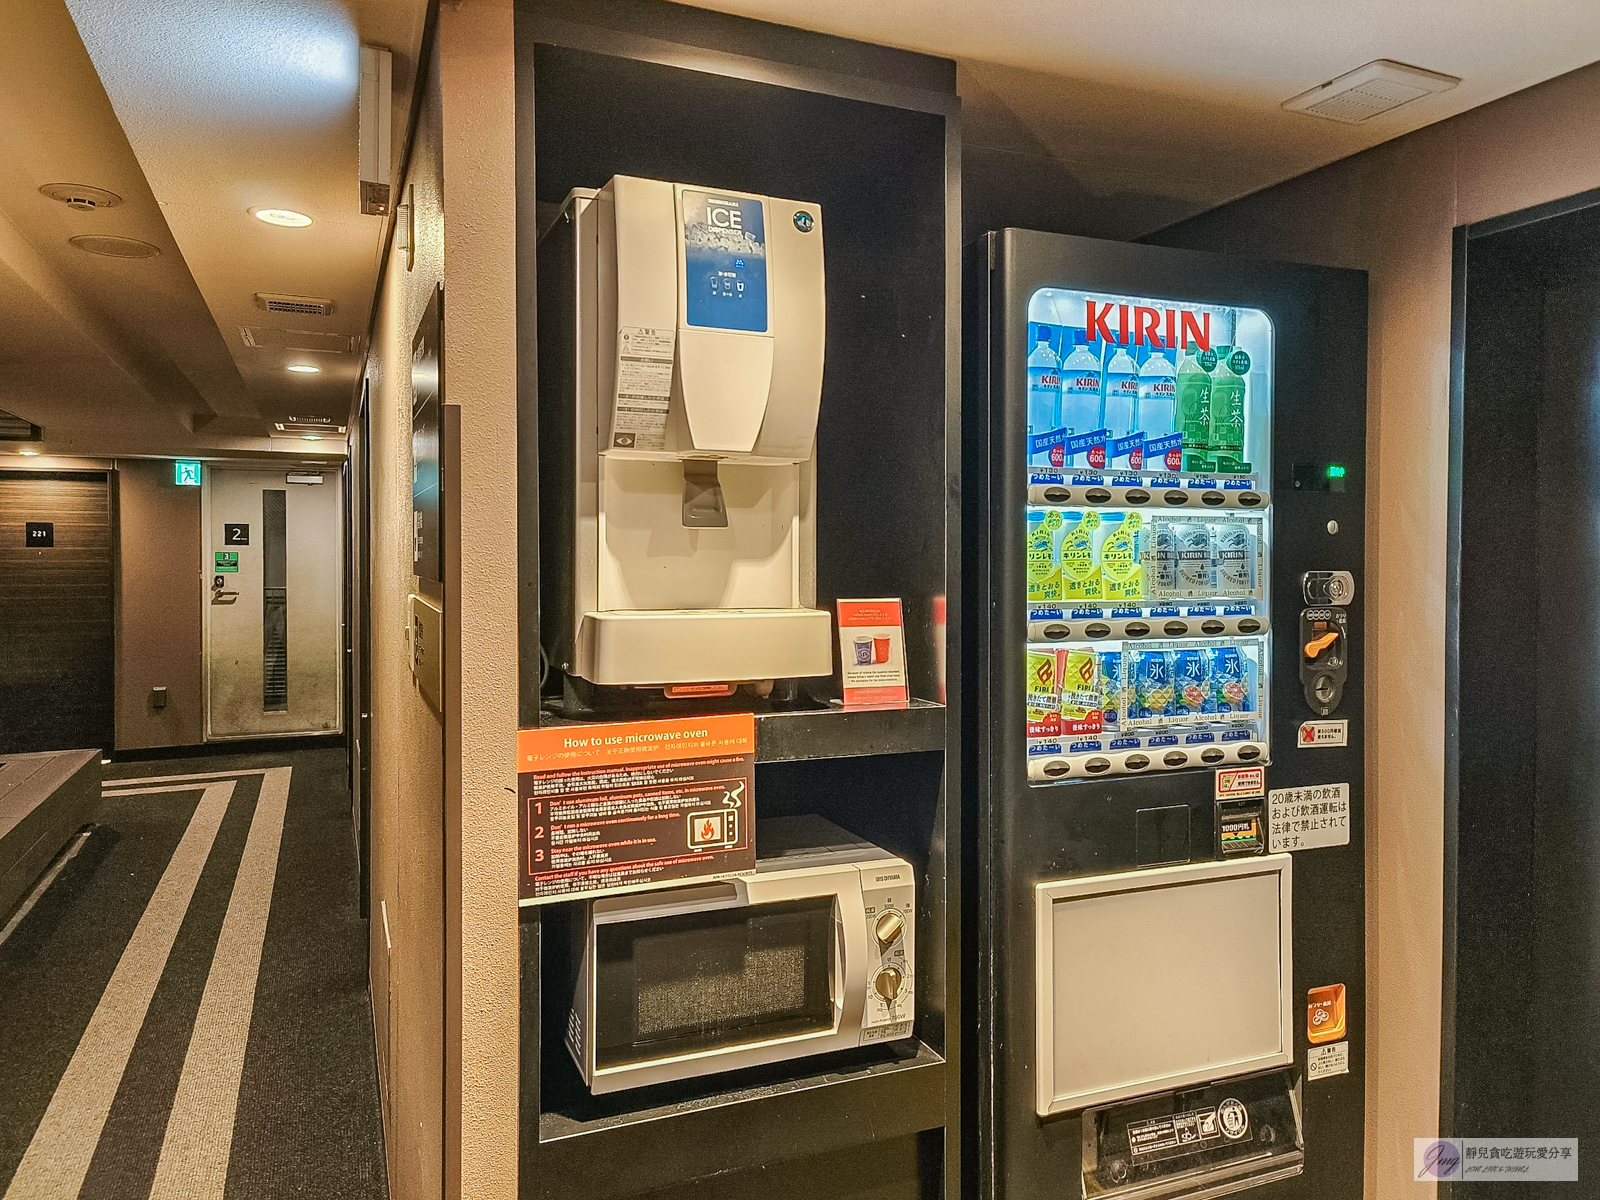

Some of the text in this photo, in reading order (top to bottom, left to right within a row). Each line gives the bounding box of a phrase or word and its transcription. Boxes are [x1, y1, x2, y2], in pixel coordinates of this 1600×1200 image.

[706, 206, 742, 229] ICE
[708, 226, 742, 236] DISPENSER
[1086, 300, 1210, 352] KIRIN
[1199, 387, 1210, 426] 生茶
[1230, 389, 1244, 428] 生茶
[232, 528, 242, 540] 2
[1150, 664, 1164, 680] 氷
[1186, 661, 1200, 678] 氷
[1224, 658, 1240, 674] 氷
[564, 730, 708, 748] How to use microwave oven
[526, 749, 600, 762] 電子レンジの使用について
[1272, 786, 1341, 805] 20歳未満の飲酒
[534, 802, 542, 814] 1
[1272, 802, 1347, 820] および飲酒運転は
[618, 815, 646, 824] continuously
[1272, 816, 1346, 834] 法律で禁止されて
[534, 826, 544, 840] 2
[1272, 836, 1304, 849] います。
[534, 848, 544, 862] 3
